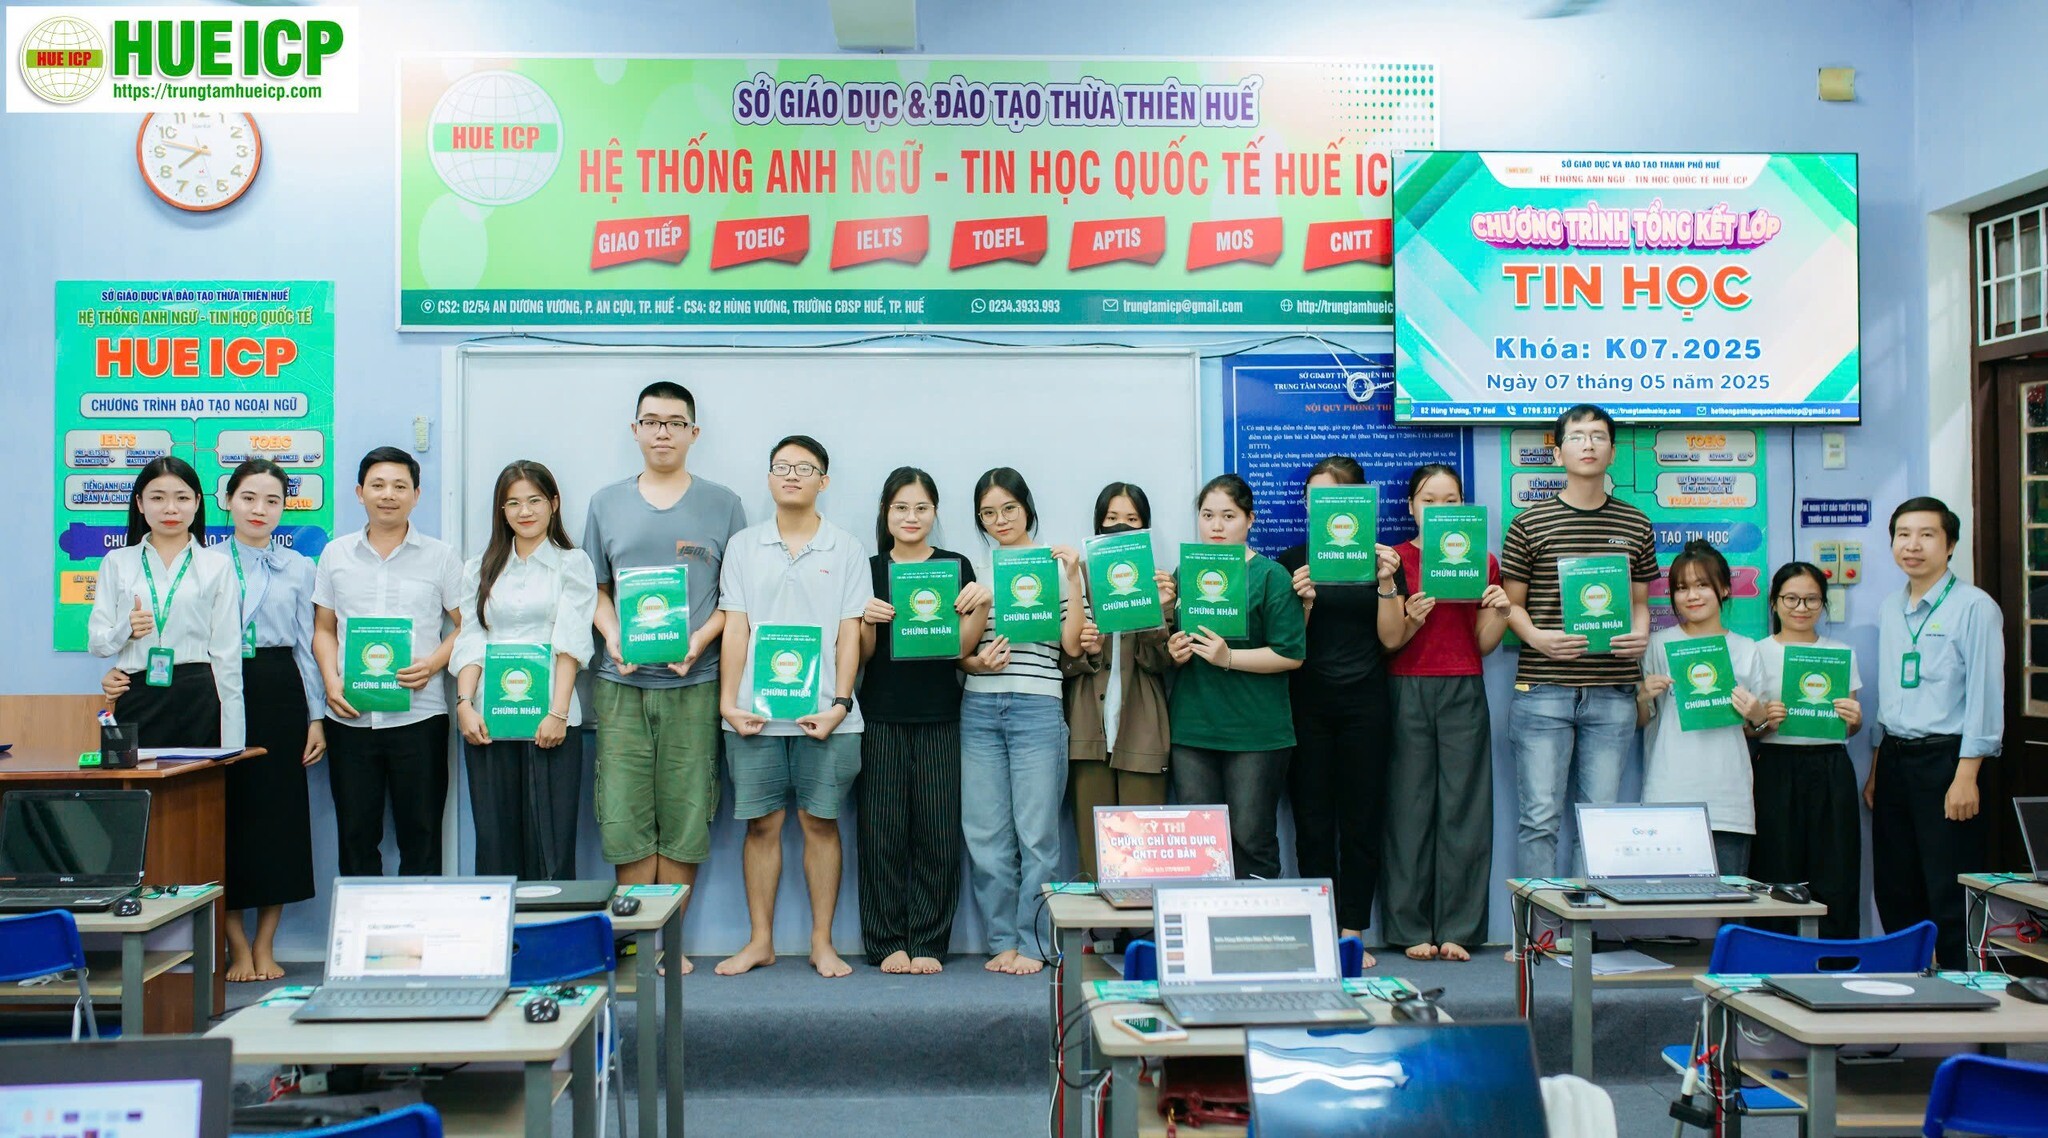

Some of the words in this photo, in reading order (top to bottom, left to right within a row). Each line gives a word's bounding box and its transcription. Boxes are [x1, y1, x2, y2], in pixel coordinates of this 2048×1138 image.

[738, 78, 770, 118] SỞ
[779, 79, 837, 118] GIÁO
[848, 89, 898, 125] DỤC
[908, 90, 928, 116] &
[935, 81, 985, 119] ĐÀO
[994, 90, 1041, 126] TẠO
[1050, 81, 1116, 119] THỪA
[1124, 82, 1196, 120] THIÊN
[1205, 80, 1261, 121] HUẾ
[159, 126, 177, 139] 10
[230, 126, 243, 139] 2
[452, 125, 495, 149] HUE
[502, 125, 540, 149] ICP
[236, 145, 248, 158] 3
[160, 165, 172, 179] 8
[230, 165, 243, 177] 4
[579, 138, 623, 204] HỆ
[636, 132, 753, 194] THỐNG
[766, 150, 836, 194] ANH
[851, 139, 924, 195] NGỮ
[961, 150, 1016, 195] TIN
[1030, 150, 1101, 205] HỌC
[1115, 134, 1209, 200] QUỐC
[1222, 135, 1266, 196] TẾ
[1275, 136, 1346, 197] HUẾ
[1356, 153, 1388, 197] IC
[177, 179, 189, 193] 7
[195, 185, 207, 198] 6
[216, 179, 229, 192] 5
[1473, 206, 1562, 243] CHƯƠNG
[1564, 202, 1629, 244] TRÌNH
[1634, 199, 1693, 245] TỔNG
[1695, 203, 1737, 244] KẾT
[1739, 208, 1781, 242] LỚP
[599, 231, 639, 254] GIAO
[644, 220, 683, 250] TIẾP
[735, 226, 785, 251] TOEIC
[856, 226, 903, 250] IELTS
[972, 226, 1025, 249] TOEFL
[1093, 227, 1141, 251] APTIS
[1216, 229, 1254, 251] MOS
[1330, 229, 1373, 252] CNTT
[102, 288, 115, 301] SỞ
[117, 289, 138, 301] GIÁO
[141, 291, 159, 303] DỤC
[161, 289, 173, 301] VÀ
[175, 289, 195, 301] ĐÀO
[197, 291, 214, 303] TẠO
[216, 289, 239, 301] THỪA
[242, 289, 268, 301] THIÊN
[270, 288, 290, 301] HUẾ
[1503, 265, 1603, 304] TIN
[1623, 265, 1751, 317] HỌC
[437, 300, 460, 313] CS2:
[462, 300, 490, 313] 02/54
[492, 300, 507, 313] AN
[509, 300, 544, 313] DƯƠNG
[546, 300, 583, 315] VƯƠNG,
[585, 300, 594, 313] P.
[596, 300, 611, 313] AN
[613, 300, 636, 316] CỰU,
[639, 300, 652, 313] TP.
[655, 296, 674, 313] HUẾ
[683, 300, 707, 313] CS4:
[708, 300, 721, 313] 82
[723, 297, 751, 313] HÙNG
[754, 299, 790, 315] VƯƠNG,
[793, 296, 832, 313] TRƯỜNG
[835, 300, 861, 313] CĐSP
[863, 296, 886, 315] HUẾ,
[888, 300, 902, 313] TP.
[904, 296, 925, 313] HUẾ
[988, 299, 1060, 314] 0234.3933.993
[1123, 299, 1243, 315] trungtamicp@gmail.com
[1297, 299, 1394, 316] http://trungtamhueic
[78, 309, 94, 328] HỆ
[98, 306, 138, 325] THỐNG
[143, 310, 168, 324] ANH
[171, 308, 199, 324] NGỮ
[209, 310, 230, 324] TIN
[232, 310, 256, 327] HỌC
[260, 306, 293, 327] QUỐC
[297, 305, 313, 324] TẾ
[1495, 338, 1590, 359] Khóa:
[1606, 338, 1761, 359] K07.2025
[95, 338, 200, 377] HUE
[210, 338, 298, 377] ICP
[1486, 374, 1537, 392] Ngày
[1545, 374, 1570, 389] 07
[1577, 374, 1633, 392] tháng
[1640, 374, 1665, 389] 05
[1673, 374, 1713, 389] năm
[1720, 374, 1770, 389] 2025
[91, 398, 138, 411] CHƯƠNG
[143, 398, 177, 411] TRÌNH
[181, 398, 204, 411] ĐÀO
[209, 399, 230, 414] TẠO
[234, 399, 269, 414] NGOẠI
[274, 397, 297, 411] NGỮ
[250, 435, 292, 450] TOEIC
[1661, 531, 1682, 546] TẠO
[1686, 531, 1703, 543] TIN
[1707, 531, 1729, 545] HỌC
[1317, 550, 1345, 559] CHỨNG
[1347, 551, 1368, 561] NHẬN
[1431, 568, 1457, 577] CHỨNG
[1458, 568, 1479, 578] NHẬN
[1103, 601, 1129, 611] CHỨNG
[1130, 597, 1152, 607] NHẬN
[1188, 606, 1214, 615] CHỨNG
[1217, 607, 1238, 617] NHẬN
[1003, 612, 1030, 621] CHỨNG
[1032, 611, 1053, 621] NHẬN
[902, 626, 928, 636] CHỨNG
[930, 625, 952, 636] NHẬN
[1573, 621, 1600, 631] CHỨNG
[1602, 620, 1623, 630] NHẬN
[629, 632, 656, 642] CHỨNG
[658, 631, 679, 641] NHẬN
[761, 688, 787, 697] CHỨNG
[491, 706, 517, 715] CHỨNG
[519, 706, 541, 716] NHẬN
[1685, 699, 1711, 710] CHỨNG
[1163, 822, 1185, 833] THI
[1631, 827, 1657, 836] Google
[1132, 849, 1158, 859] CNTT
[1160, 848, 1175, 859] CƠ
[1177, 847, 1197, 859] BẢN
